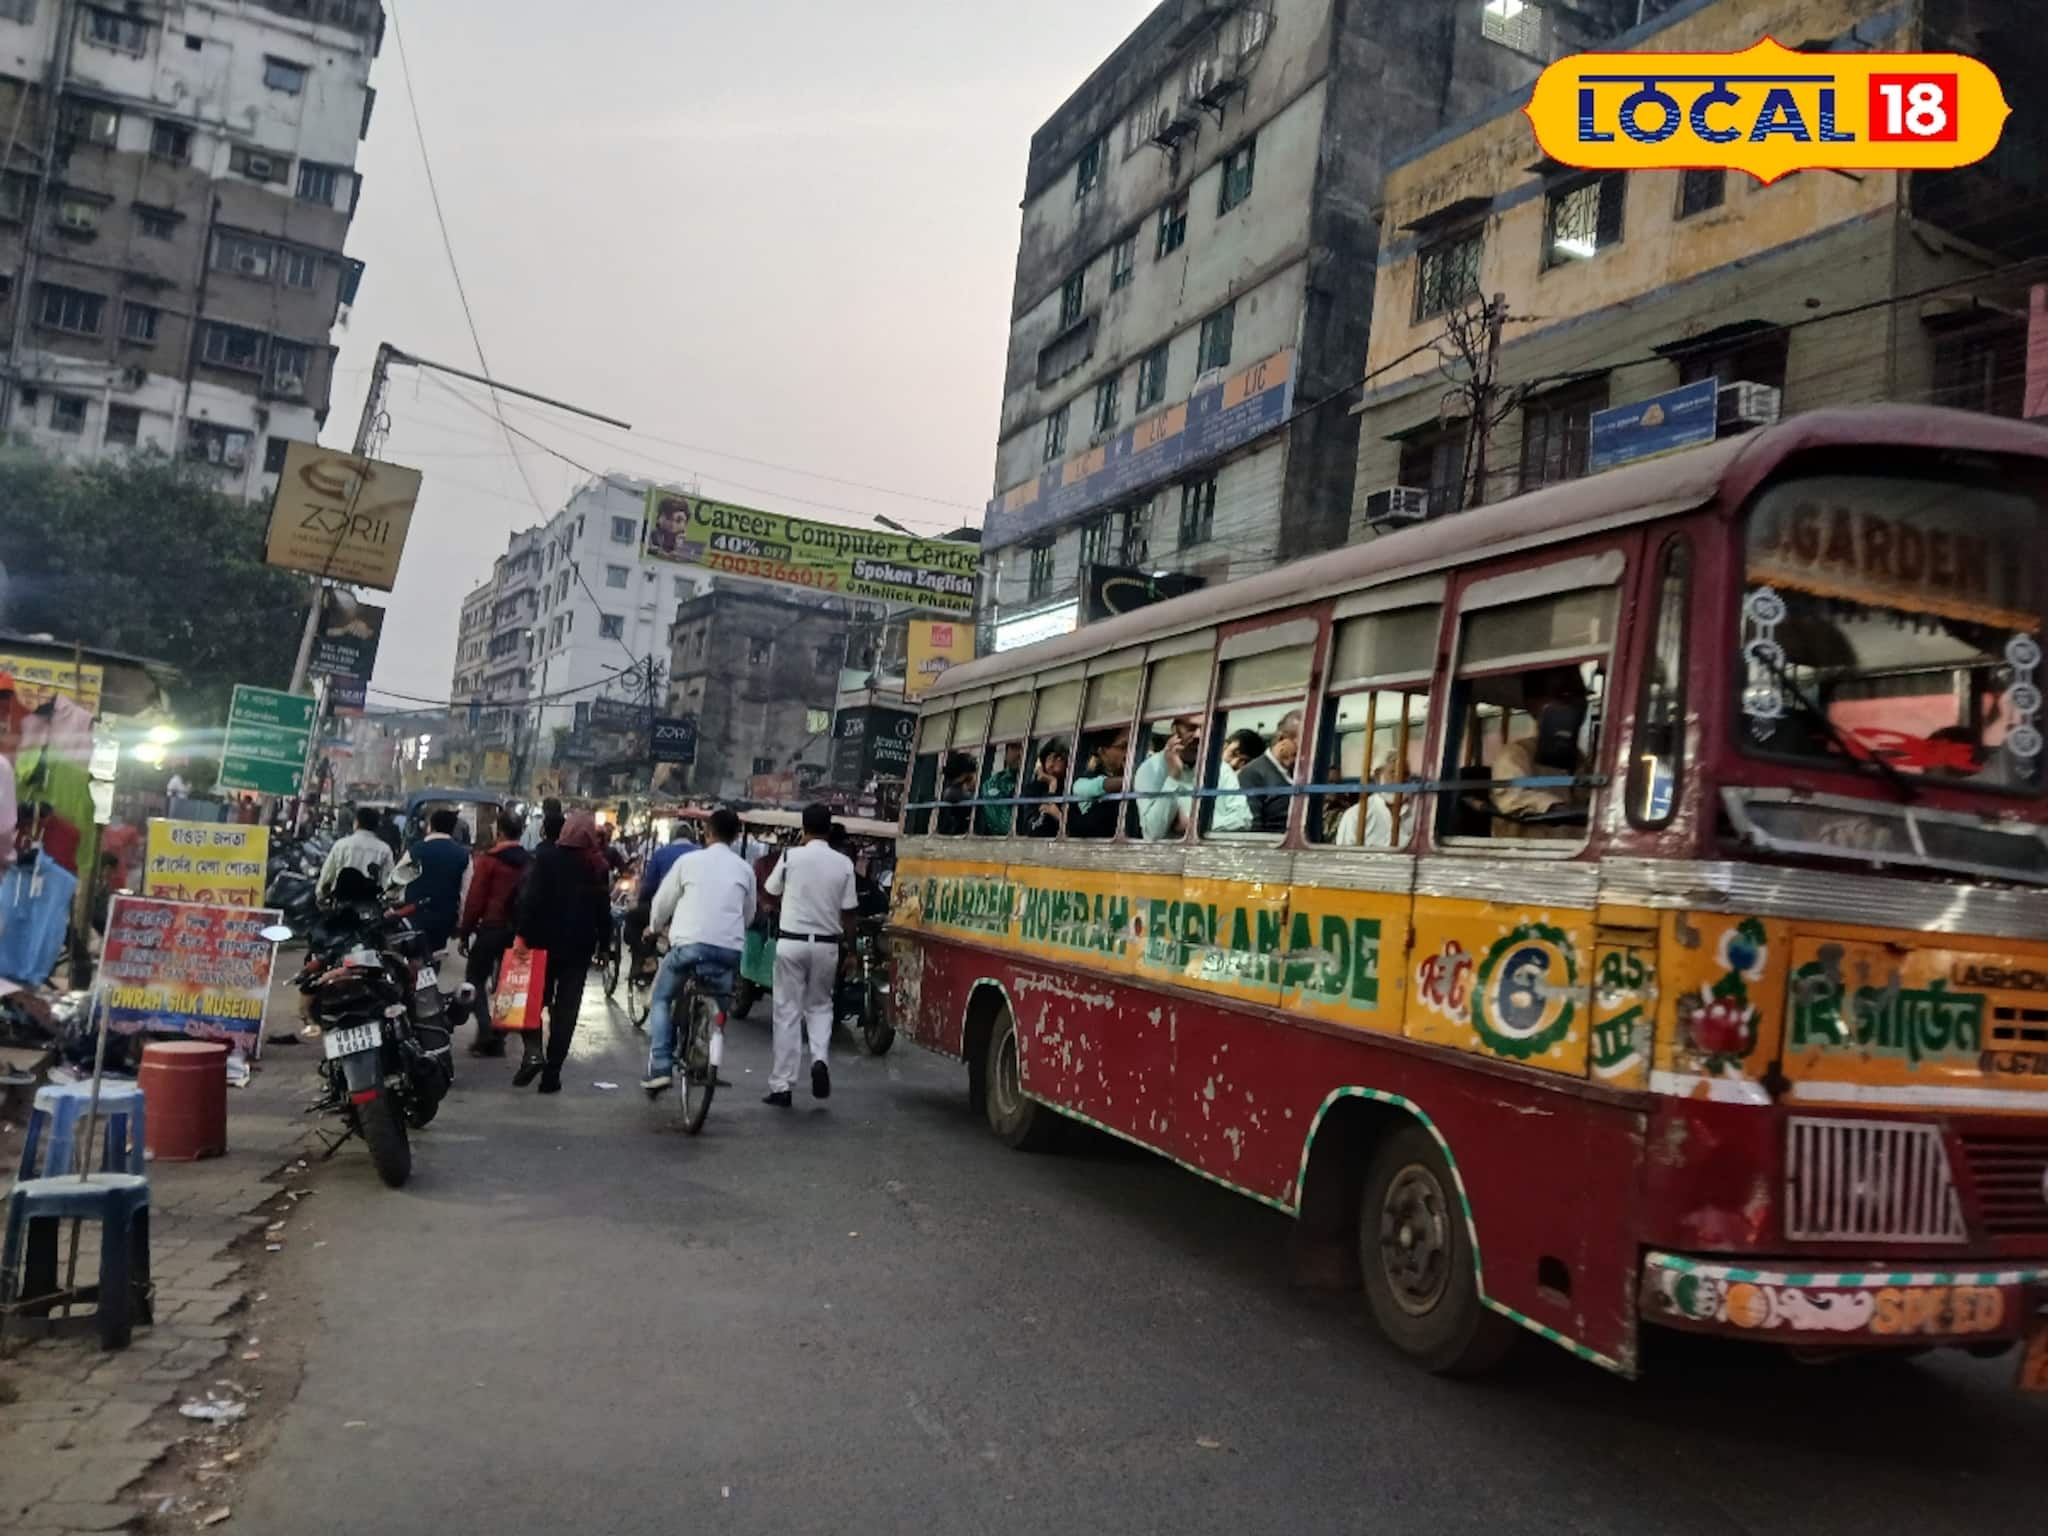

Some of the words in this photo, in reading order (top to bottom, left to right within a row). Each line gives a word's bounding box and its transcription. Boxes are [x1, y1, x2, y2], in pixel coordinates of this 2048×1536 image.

[1243, 363, 1267, 397] LIC
[300, 503, 390, 544] ZORII
[694, 500, 777, 537] Career
[785, 517, 899, 559] Computer
[906, 541, 979, 571] Centre
[712, 534, 760, 557] 40%
[763, 544, 789, 560] OFF
[708, 552, 839, 591] 7003366012
[854, 559, 913, 584] Spoken
[916, 569, 972, 595] English
[857, 583, 913, 602] Mallick
[1020, 886, 1128, 956] HOWRAH
[1145, 899, 1382, 1006] ESPLANADE
[111, 985, 164, 1010] OWRAH
[167, 987, 200, 1014] SILK
[201, 990, 262, 1019] MUSEUM
[1498, 946, 1550, 1031] 6
